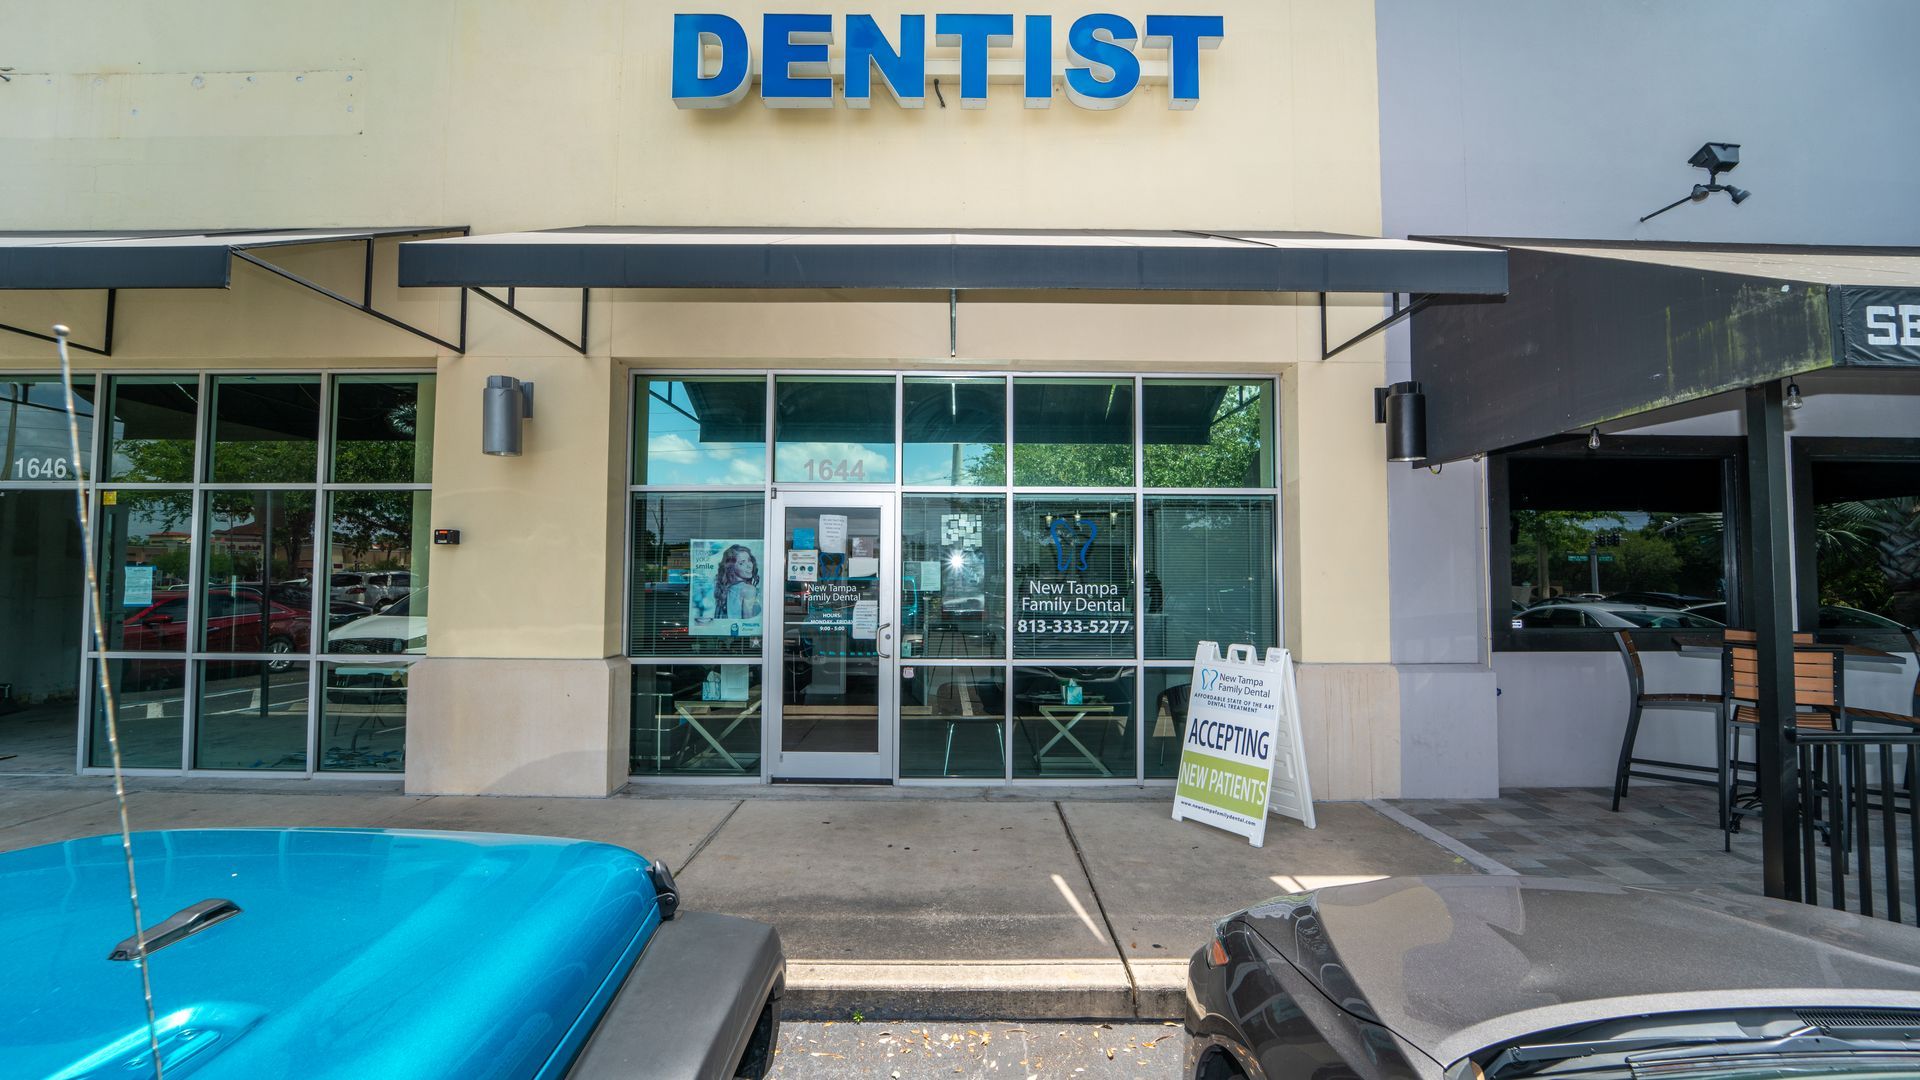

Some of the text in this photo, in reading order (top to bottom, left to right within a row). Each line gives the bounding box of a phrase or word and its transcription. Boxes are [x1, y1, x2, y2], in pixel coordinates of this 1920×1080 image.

[672, 13, 1224, 109] DENTIST
[15, 458, 67, 478] 1646
[804, 459, 865, 480] 1644
[696, 562, 714, 570] smile
[808, 583, 857, 593] New Tampa
[1029, 580, 1118, 598] New Tampa
[803, 593, 861, 603] Family Dental
[1022, 597, 1125, 614] Family Dental
[1017, 619, 1129, 633] 813-333-5277
[1219, 673, 1264, 687] New Tampa
[1194, 692, 1226, 702] AFFORDABLE
[1227, 697, 1242, 705] STATE
[1218, 683, 1271, 698] Family Dental
[1228, 704, 1258, 713] TREATMENT
[1188, 718, 1270, 760] ACCEPTING
[1180, 761, 1266, 805] NEW PATIENTS
[1180, 801, 1256, 826] www.newtampafamilydental.com
